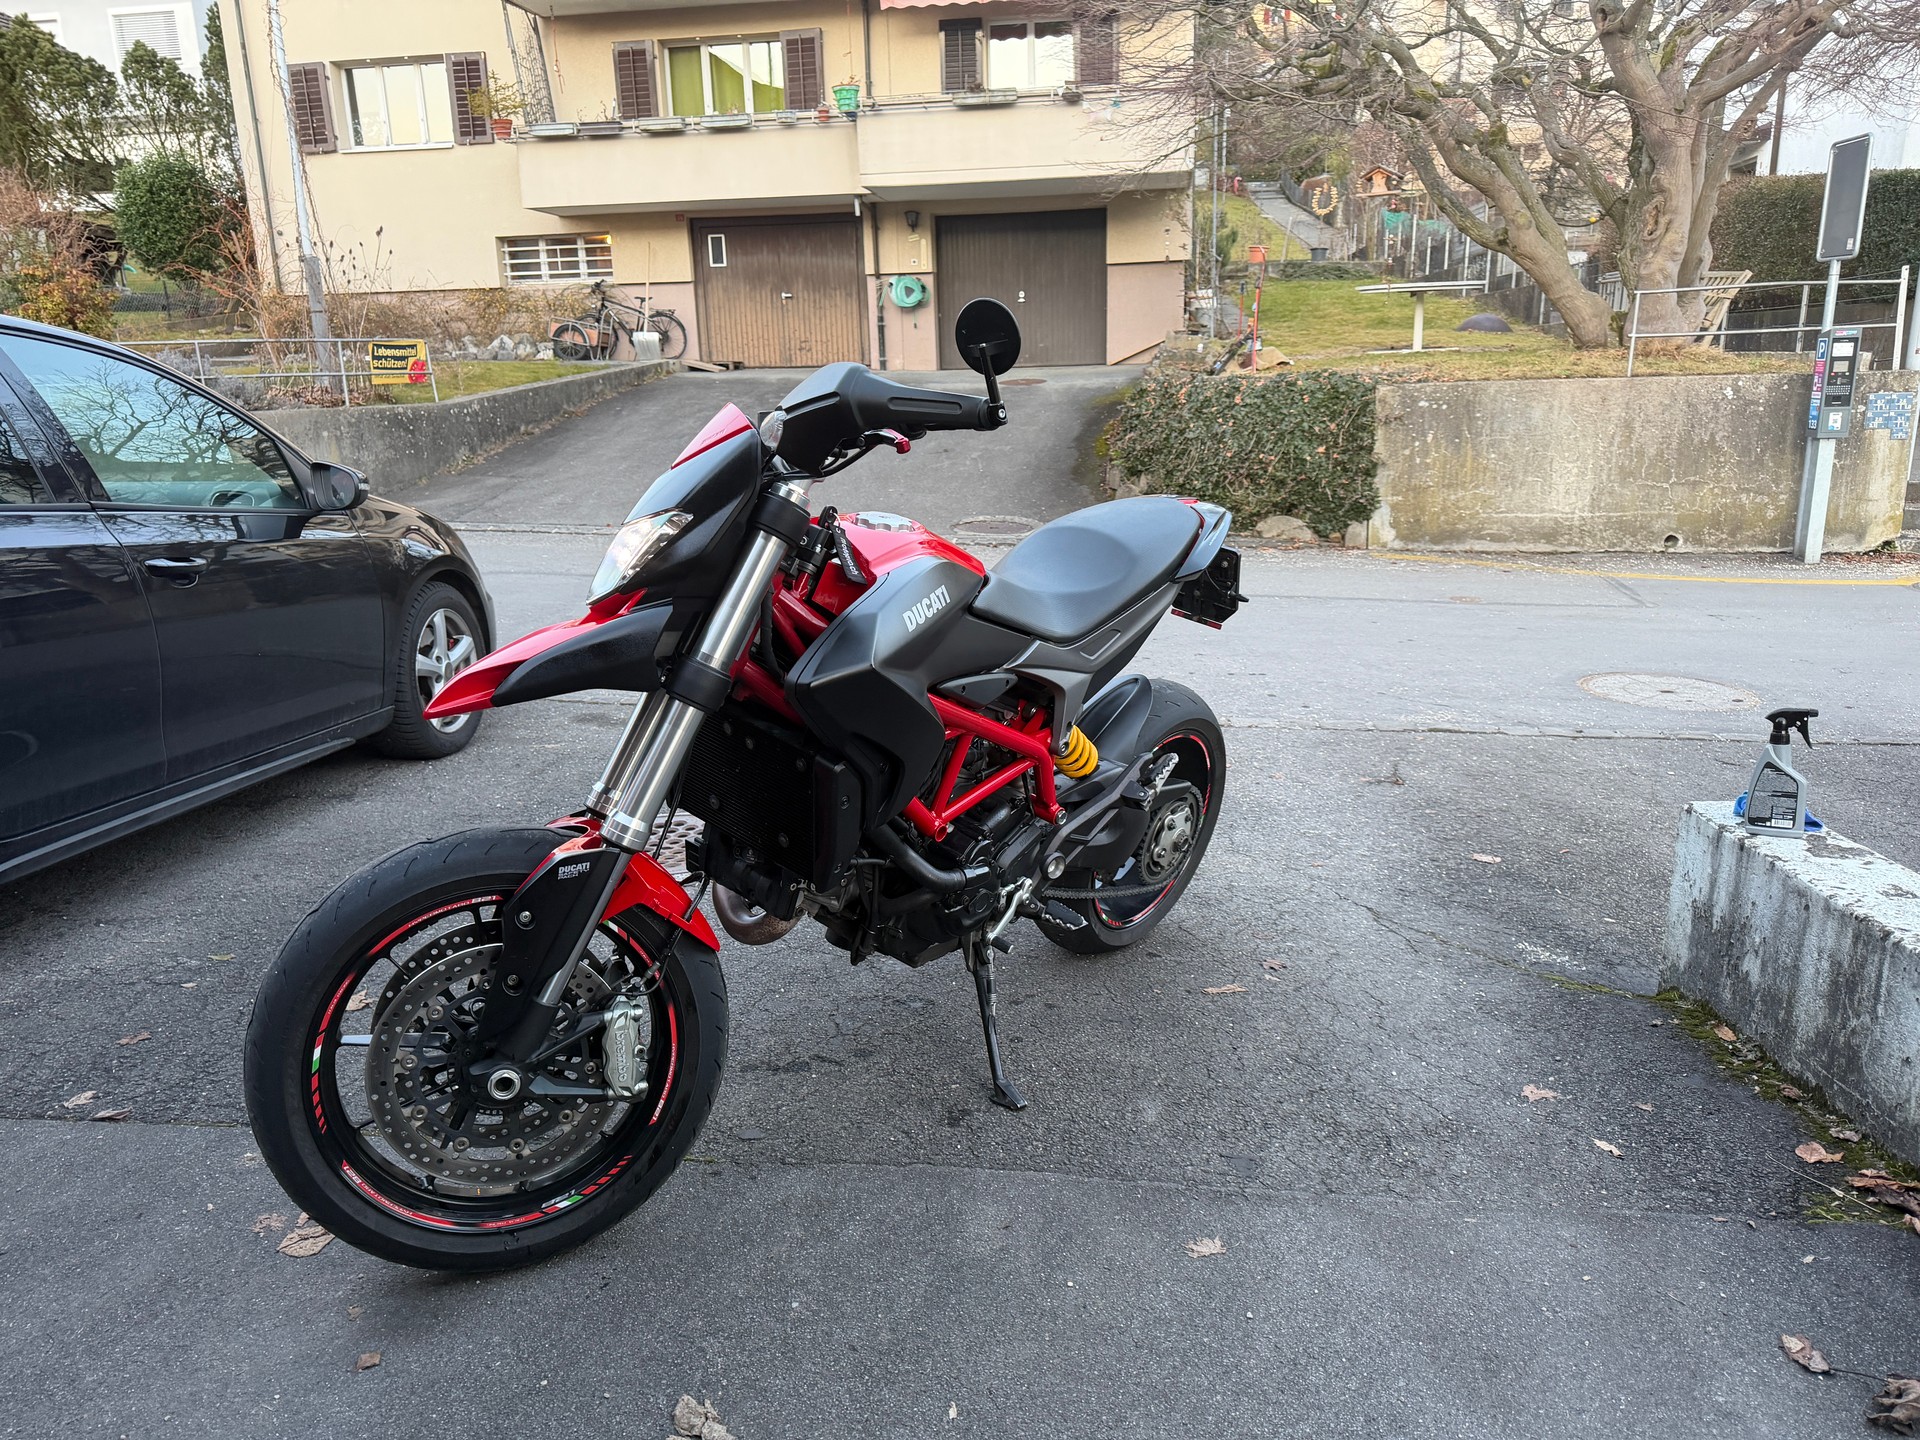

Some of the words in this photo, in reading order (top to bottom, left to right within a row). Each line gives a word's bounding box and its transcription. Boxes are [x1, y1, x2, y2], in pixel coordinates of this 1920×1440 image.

[373, 346, 416, 356] Lebensmittel
[1818, 342, 1826, 357] P
[373, 358, 407, 368] schützen!
[902, 585, 951, 632] DUCATI
[558, 862, 590, 874] DUCATI
[614, 1029, 630, 1082] brembo
